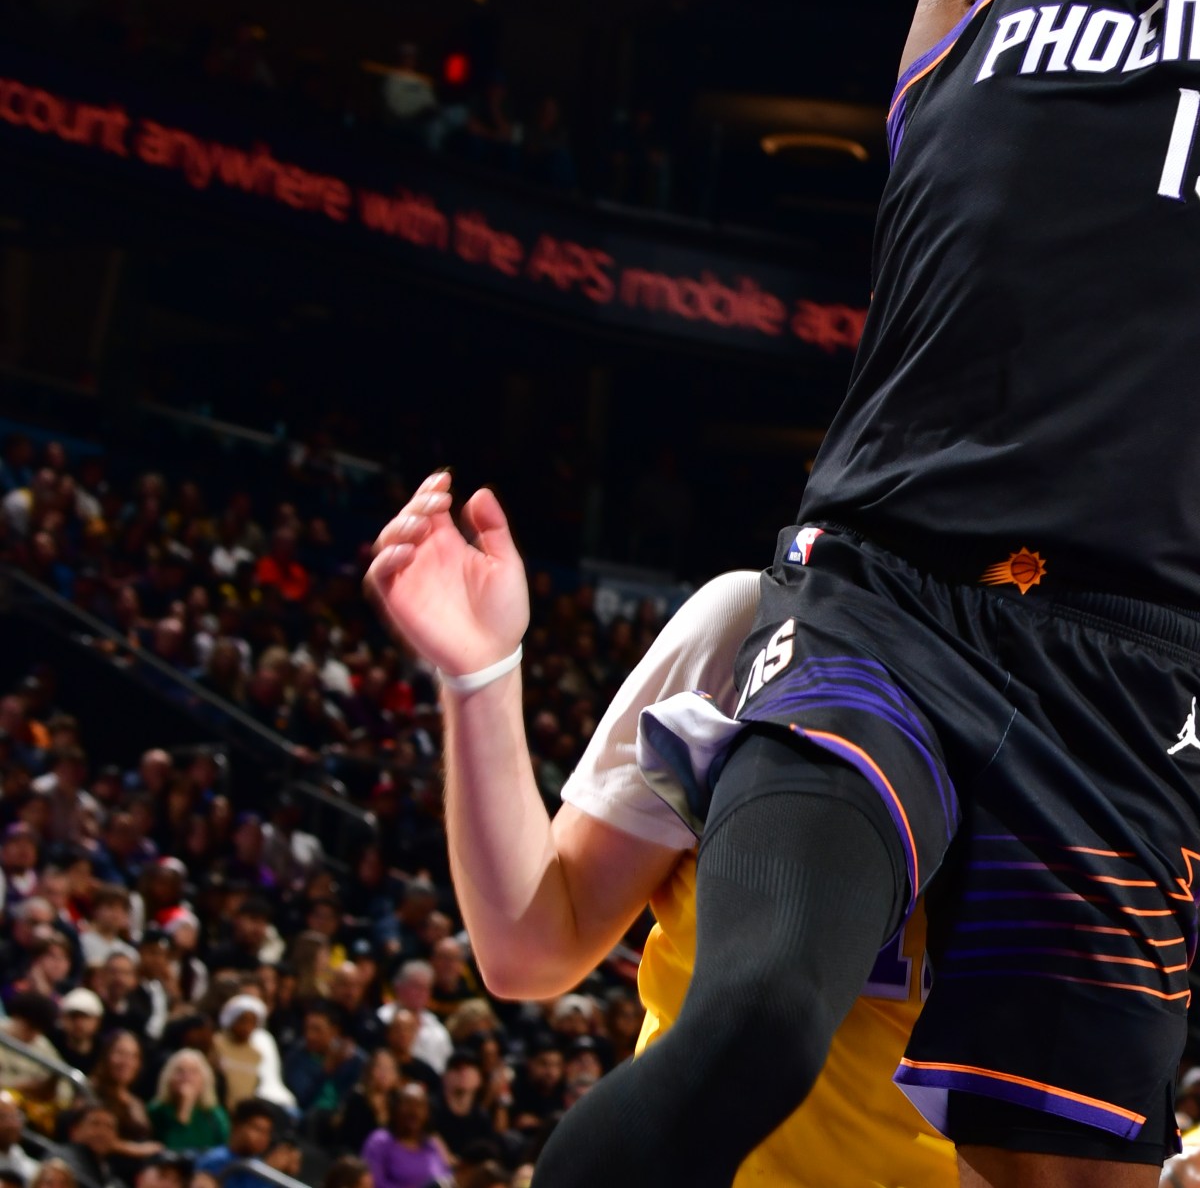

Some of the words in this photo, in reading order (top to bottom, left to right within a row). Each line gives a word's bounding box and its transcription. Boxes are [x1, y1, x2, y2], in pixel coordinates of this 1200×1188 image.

[132, 116, 353, 224] anywhere
[358, 184, 450, 252] with
[452, 209, 526, 278] the
[526, 232, 617, 305] APS
[618, 267, 789, 338] mobile
[790, 298, 869, 355] ap
